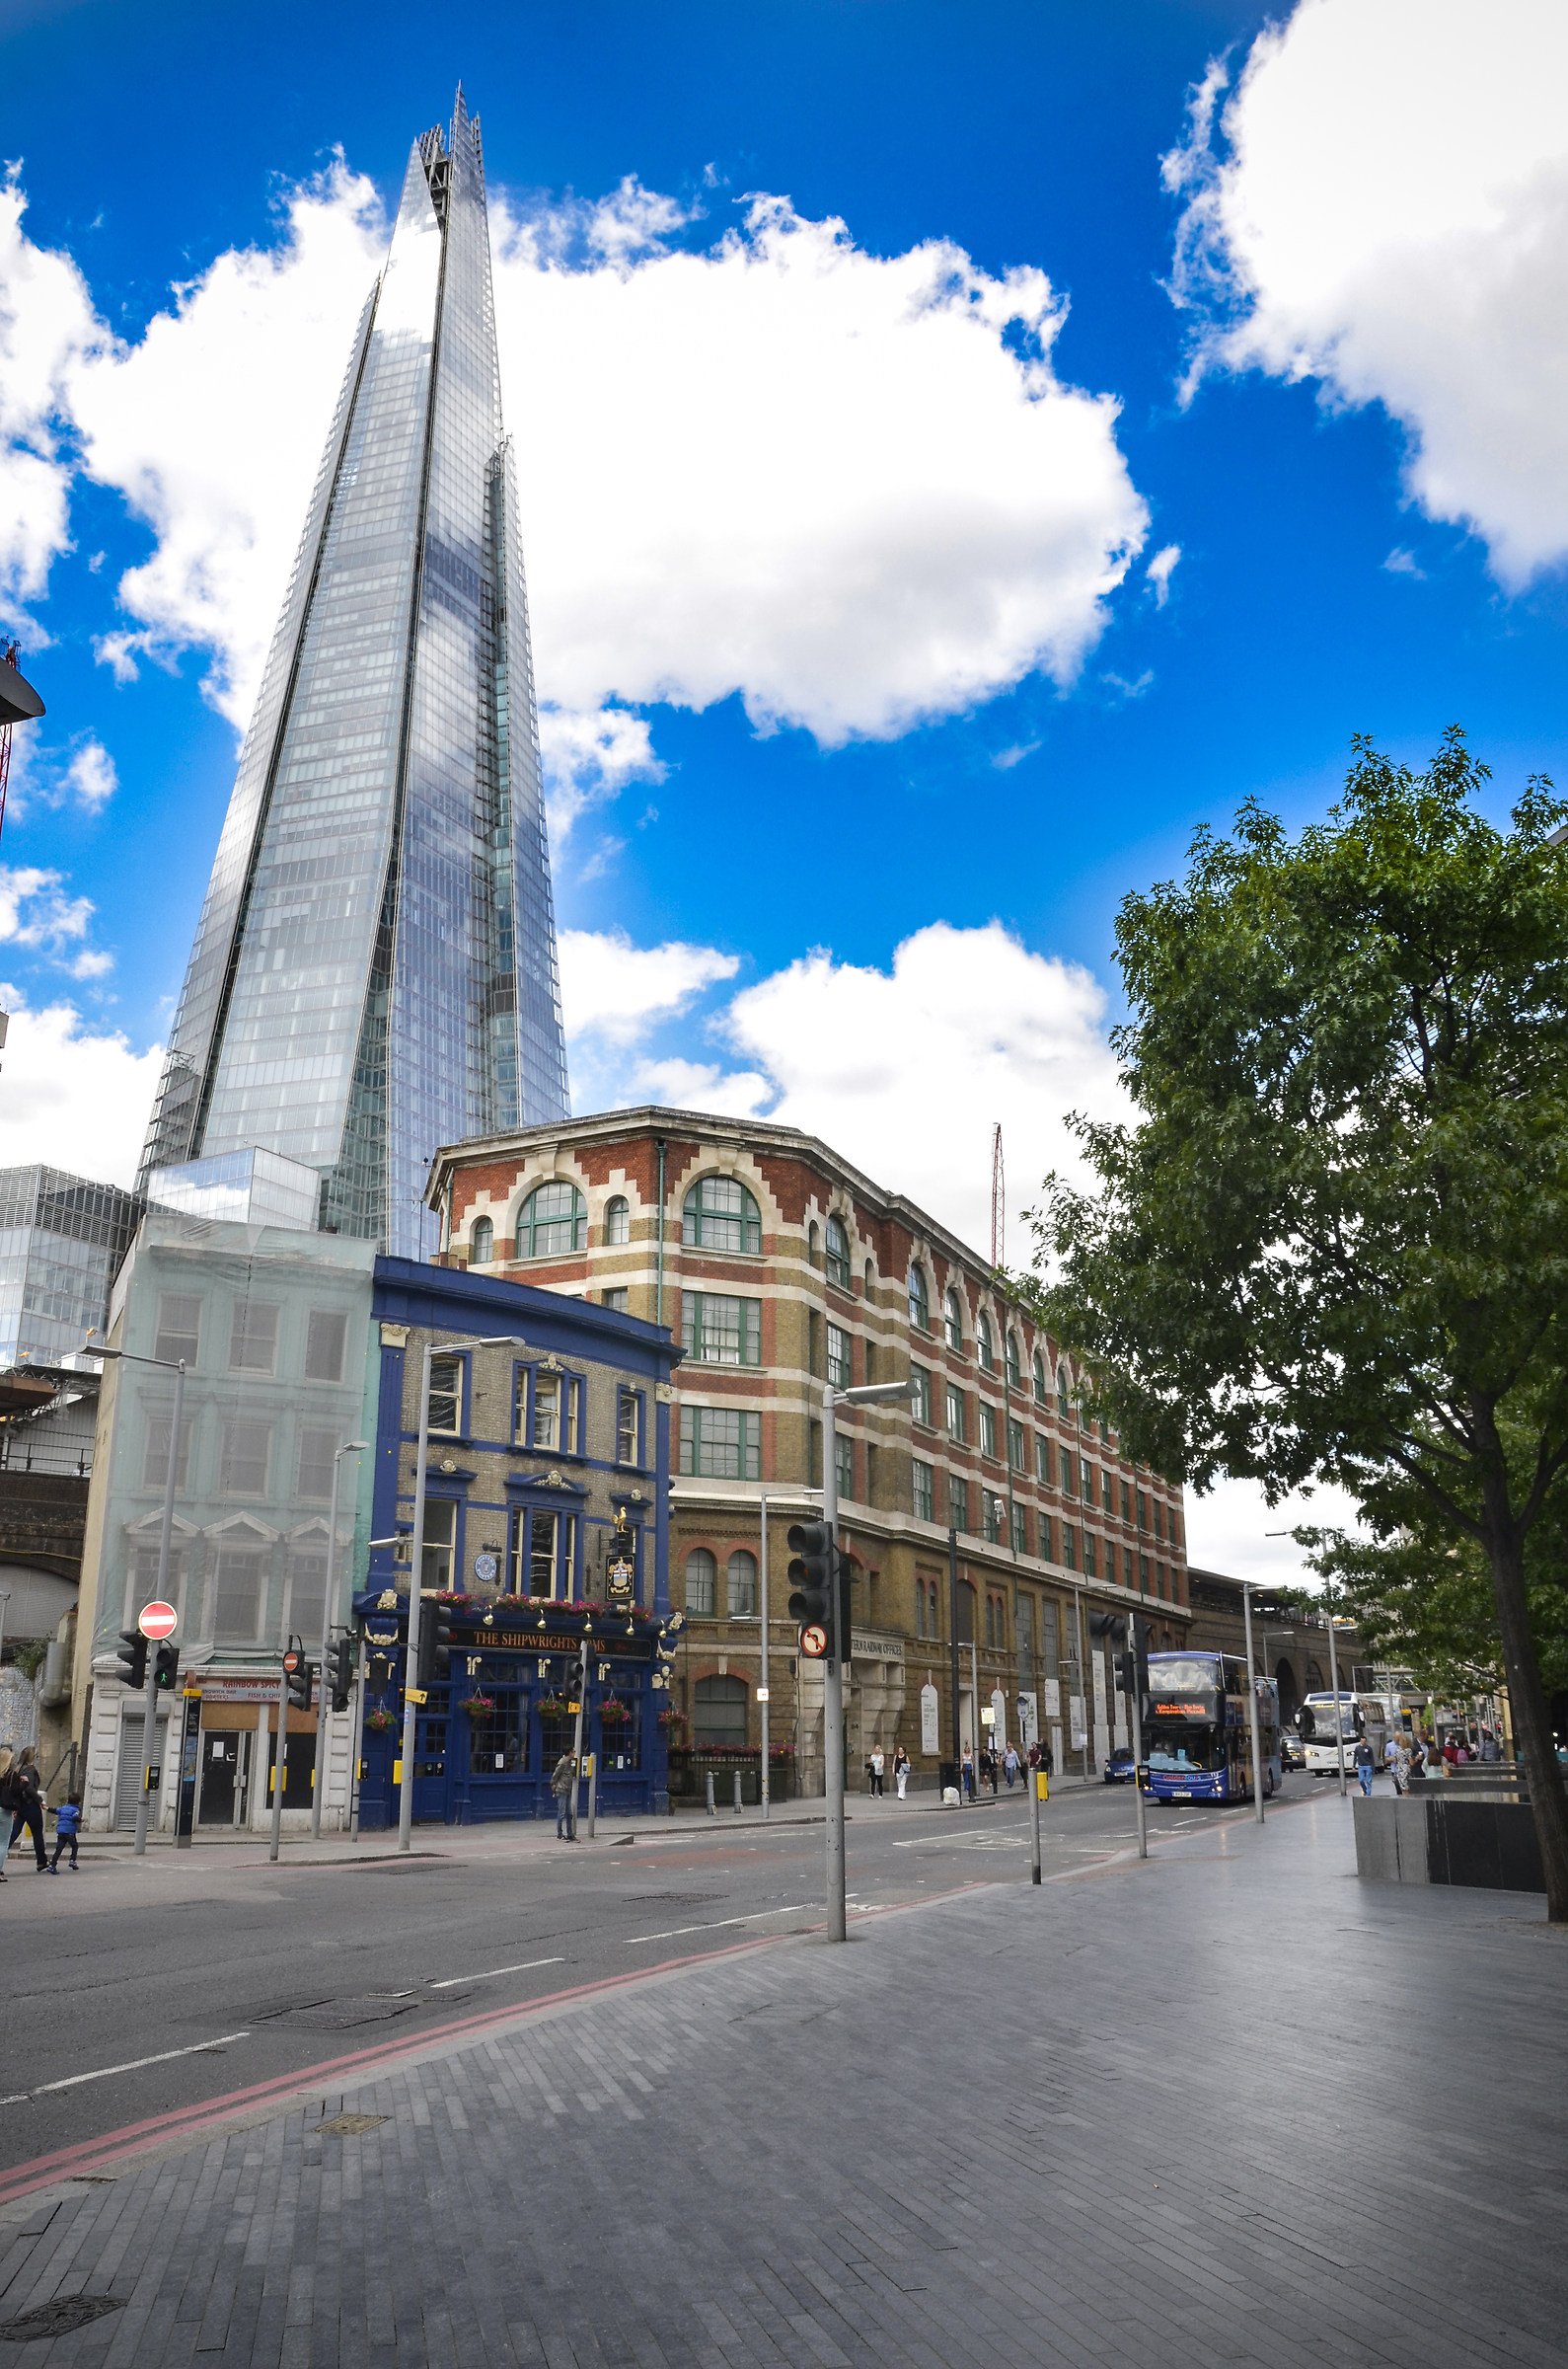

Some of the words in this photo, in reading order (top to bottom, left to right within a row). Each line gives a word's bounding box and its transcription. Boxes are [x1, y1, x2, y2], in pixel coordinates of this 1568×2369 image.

[473, 1631, 498, 1645] THE
[501, 1633, 576, 1650] SHIPWRIGHTS
[580, 1638, 606, 1653] RMS
[883, 1643, 902, 1656] OFFICES
[223, 1680, 259, 1689] RAINBOW
[261, 1680, 281, 1689] SPICY
